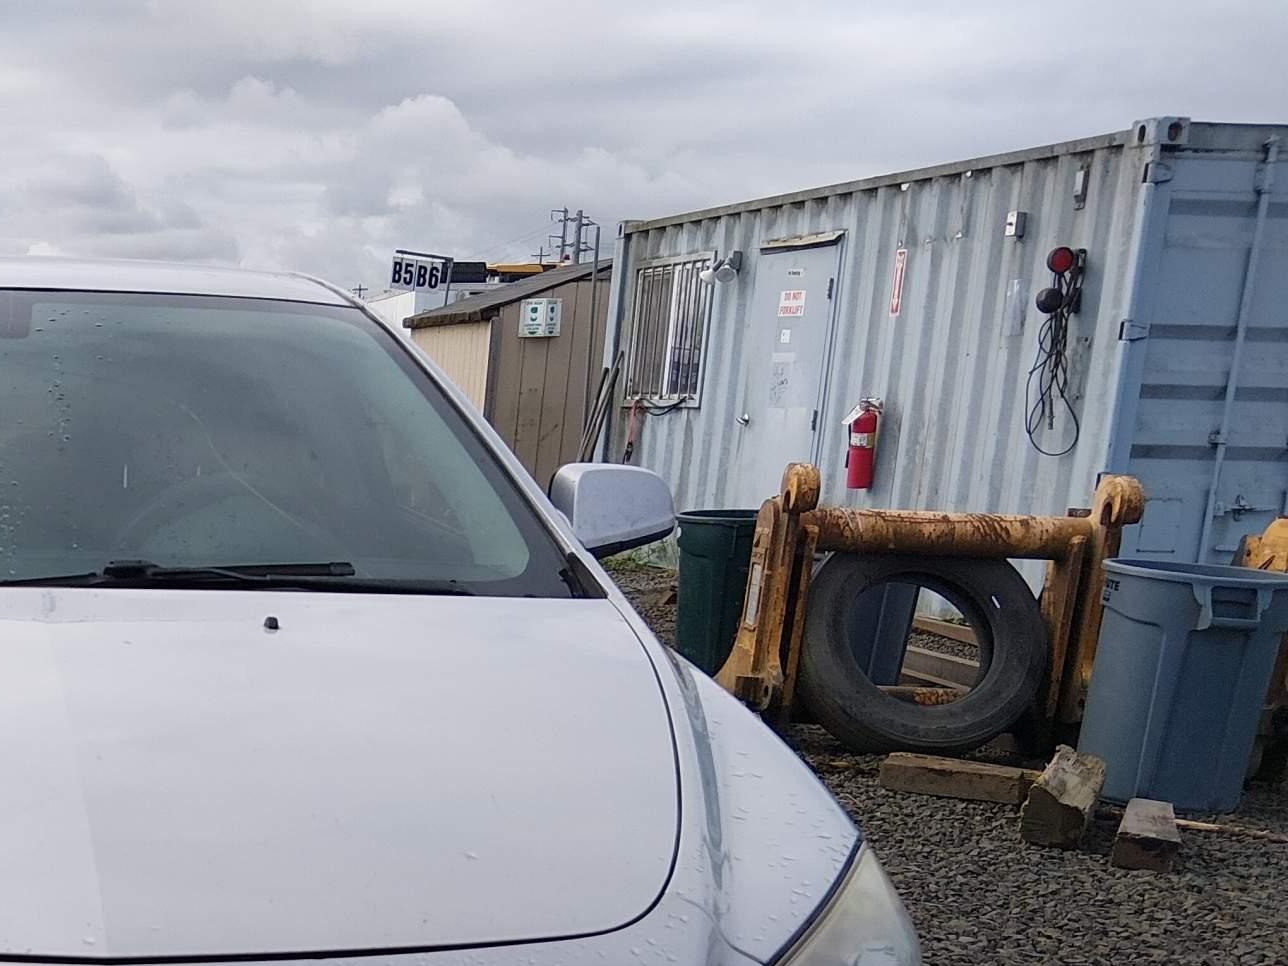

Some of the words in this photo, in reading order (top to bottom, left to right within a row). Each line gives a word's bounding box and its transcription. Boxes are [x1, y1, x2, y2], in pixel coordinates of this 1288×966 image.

[392, 261, 414, 285] B5
[416, 265, 440, 289] B6
[792, 292, 802, 301] NOT
[779, 304, 804, 314] FORKLIFT
